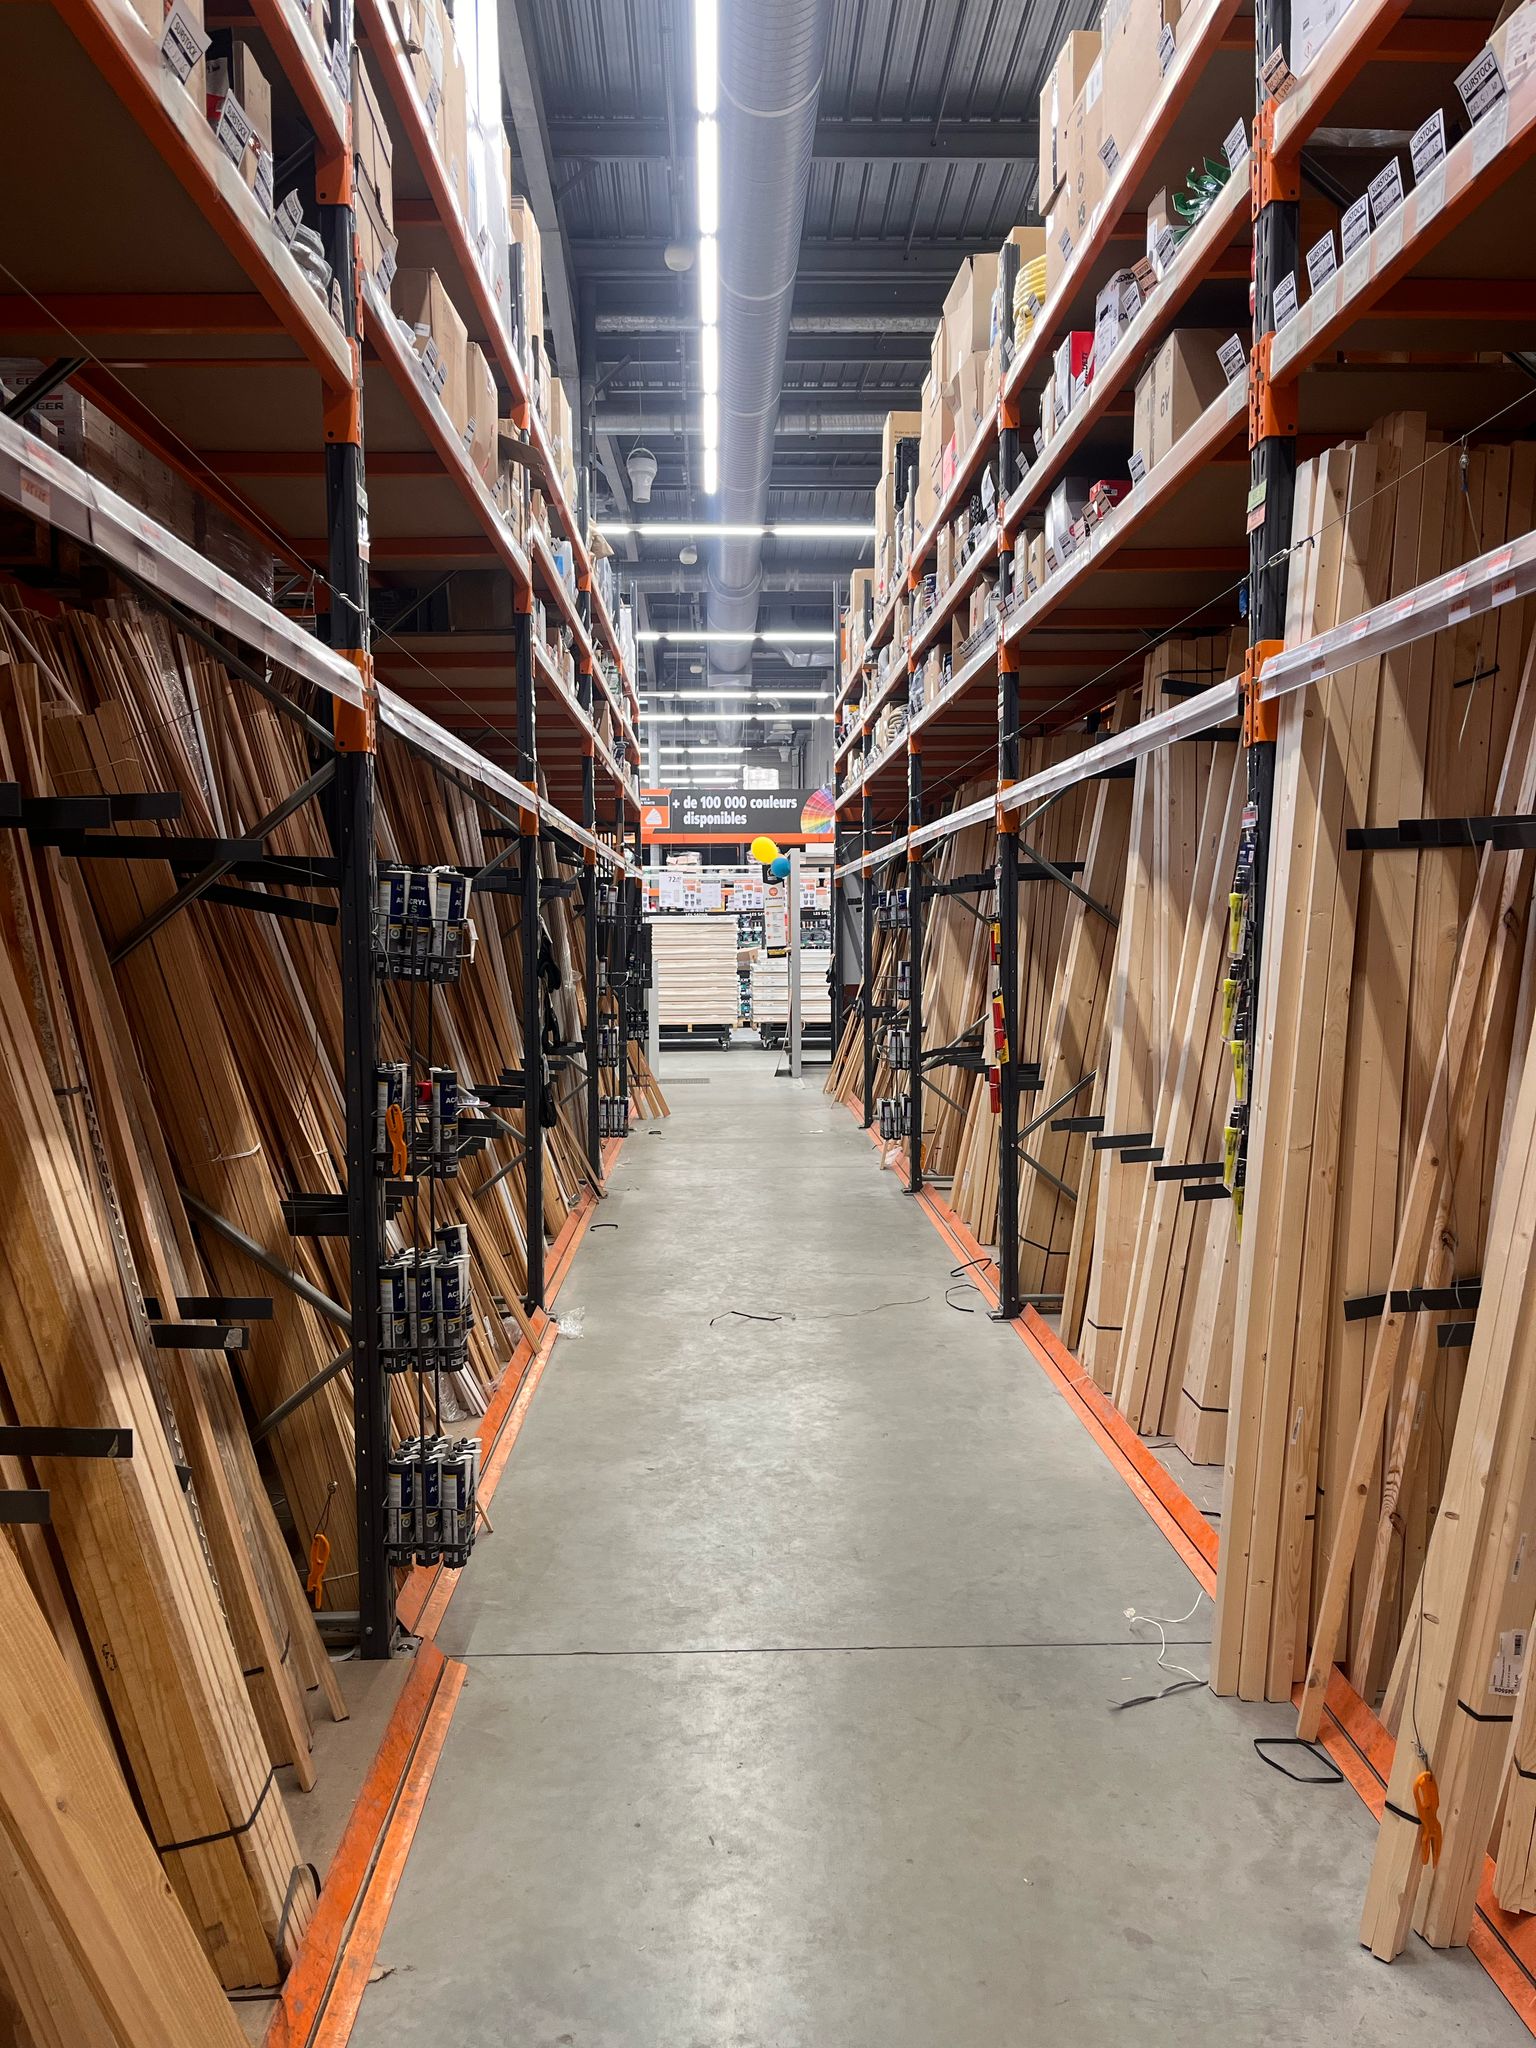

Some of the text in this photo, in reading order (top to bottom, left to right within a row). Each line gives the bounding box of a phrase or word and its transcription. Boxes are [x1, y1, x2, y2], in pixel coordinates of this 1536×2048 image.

[174, 21, 198, 59] SURSTOCK
[1463, 58, 1493, 94] SURSTOCK
[226, 104, 249, 139] SURSTOCK
[1413, 121, 1438, 151] SURSTOCK
[1371, 166, 1395, 194] SURSTOCK
[36, 402, 65, 411] GER
[683, 795, 698, 809] de
[700, 796, 721, 809] 100
[724, 795, 748, 809] 000
[750, 795, 798, 809] couleurs
[683, 811, 748, 828] disponibles
